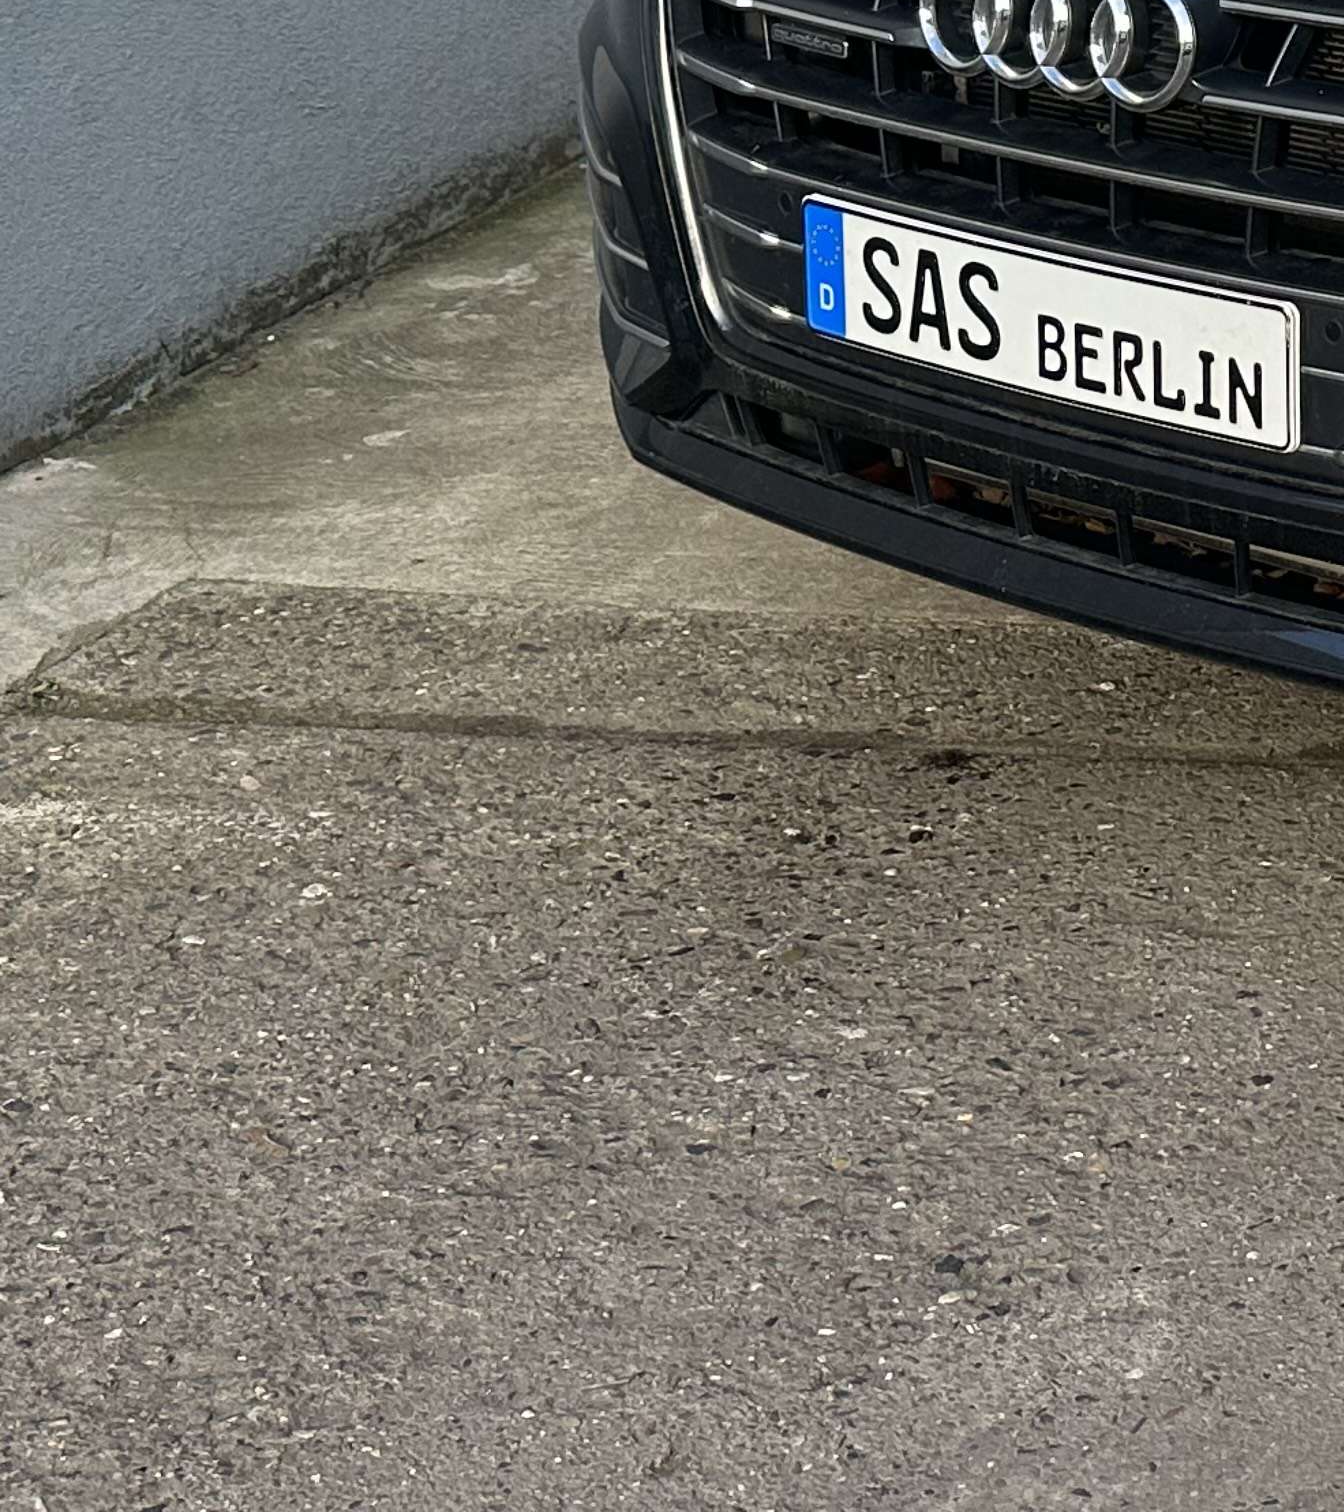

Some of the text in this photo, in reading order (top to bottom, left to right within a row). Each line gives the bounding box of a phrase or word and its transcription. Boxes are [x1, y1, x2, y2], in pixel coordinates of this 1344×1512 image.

[774, 29, 843, 54] quattro
[818, 283, 835, 312] D
[862, 236, 1263, 430] SAS BERLIN
